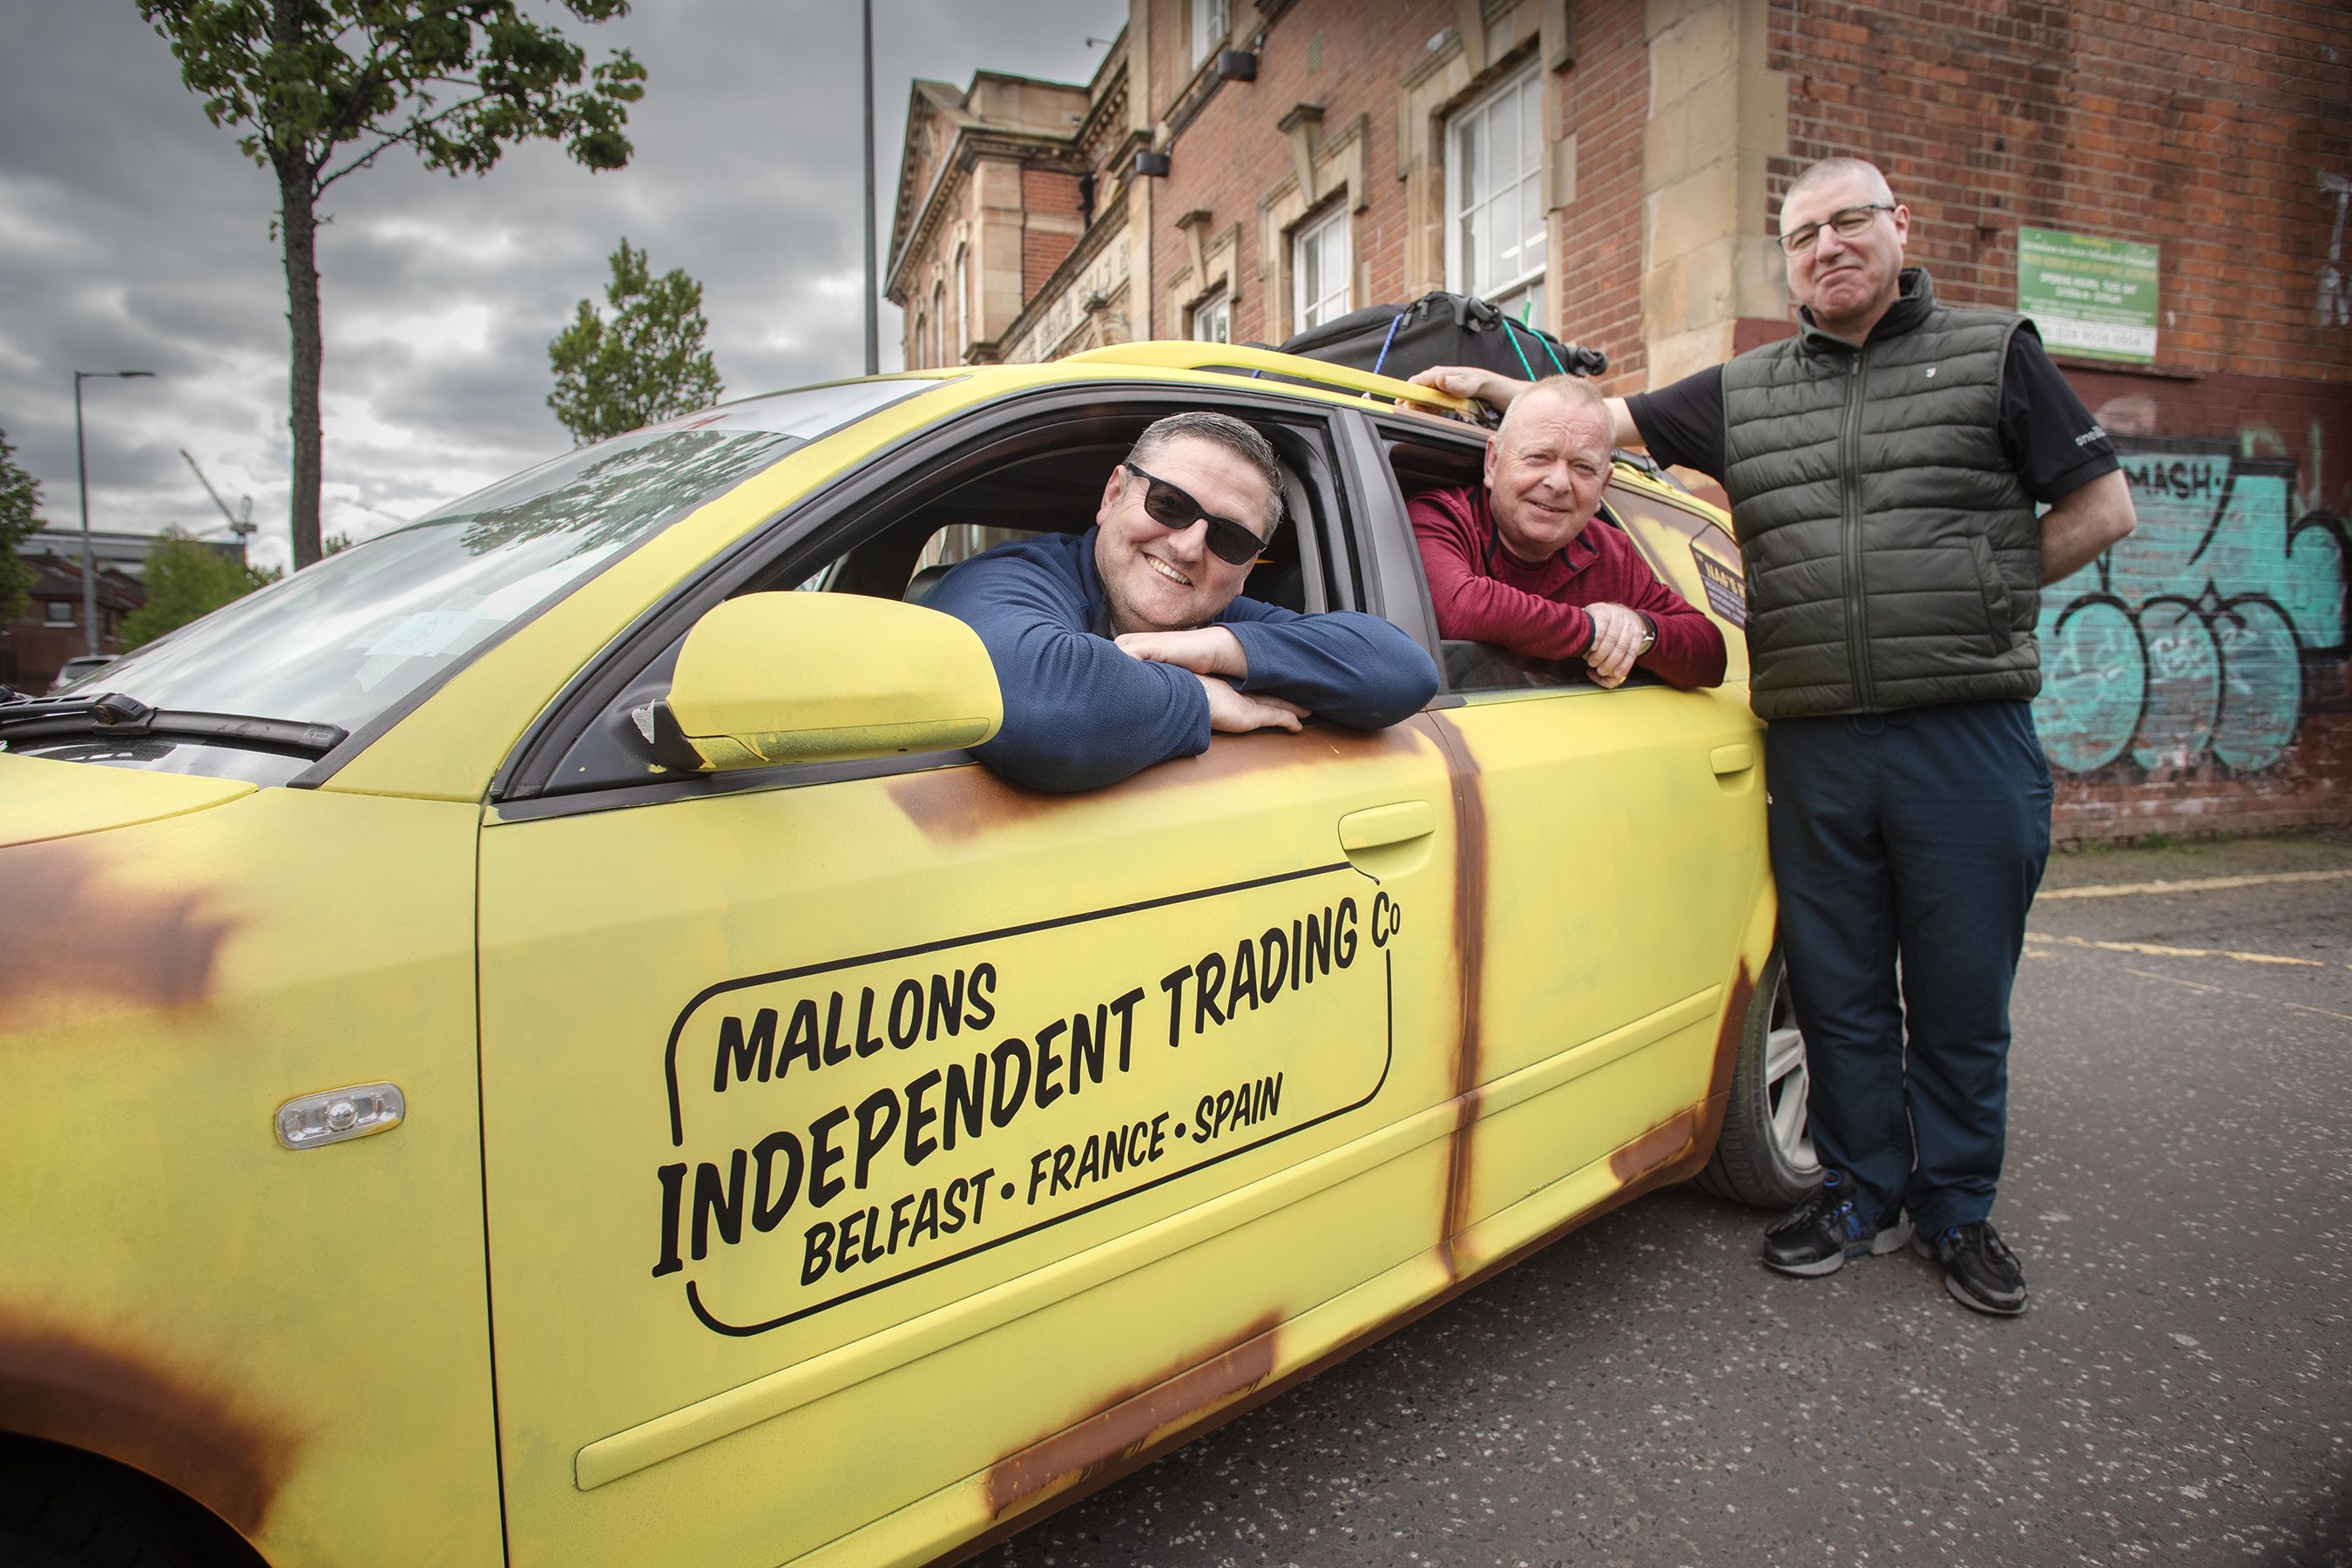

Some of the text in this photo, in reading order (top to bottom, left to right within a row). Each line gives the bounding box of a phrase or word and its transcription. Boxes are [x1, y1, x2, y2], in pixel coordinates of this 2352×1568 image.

[651, 986, 1146, 1279] INDEPENDENT
[1160, 896, 1358, 1048] TRADING
[713, 963, 997, 1093] MALLONS
[801, 1071, 1283, 1287] BELFAST FRANCE SPAIN
